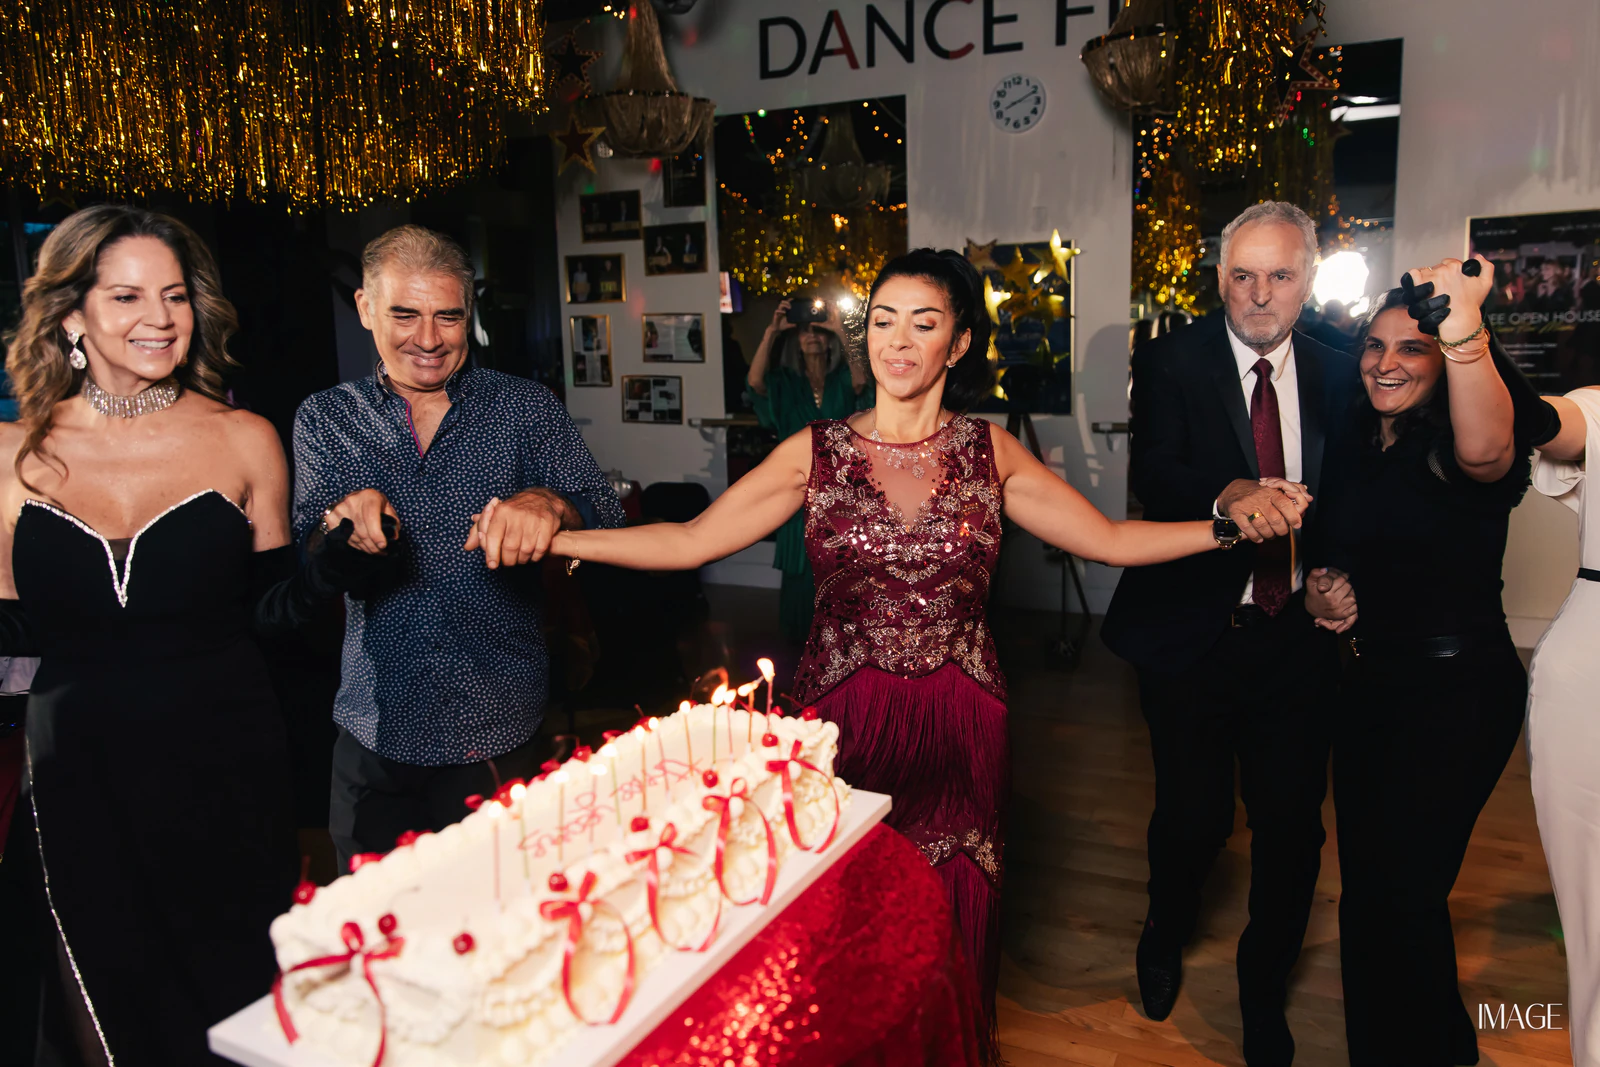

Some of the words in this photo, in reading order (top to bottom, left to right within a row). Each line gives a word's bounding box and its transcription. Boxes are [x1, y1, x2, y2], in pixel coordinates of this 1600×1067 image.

[758, 0, 1024, 80] DANCE
[1012, 76, 1022, 85] 12
[997, 90, 1006, 98] 10
[993, 100, 1000, 109] 9
[1034, 96, 1040, 105] 3
[996, 110, 1003, 119] 8
[1031, 107, 1037, 115] 4
[1005, 117, 1010, 126] 7
[1013, 120, 1020, 128] 6
[1024, 116, 1030, 125] 5
[1488, 312, 1505, 326] EE
[1508, 311, 1550, 326] OPEN
[1552, 308, 1600, 324] HOUSE
